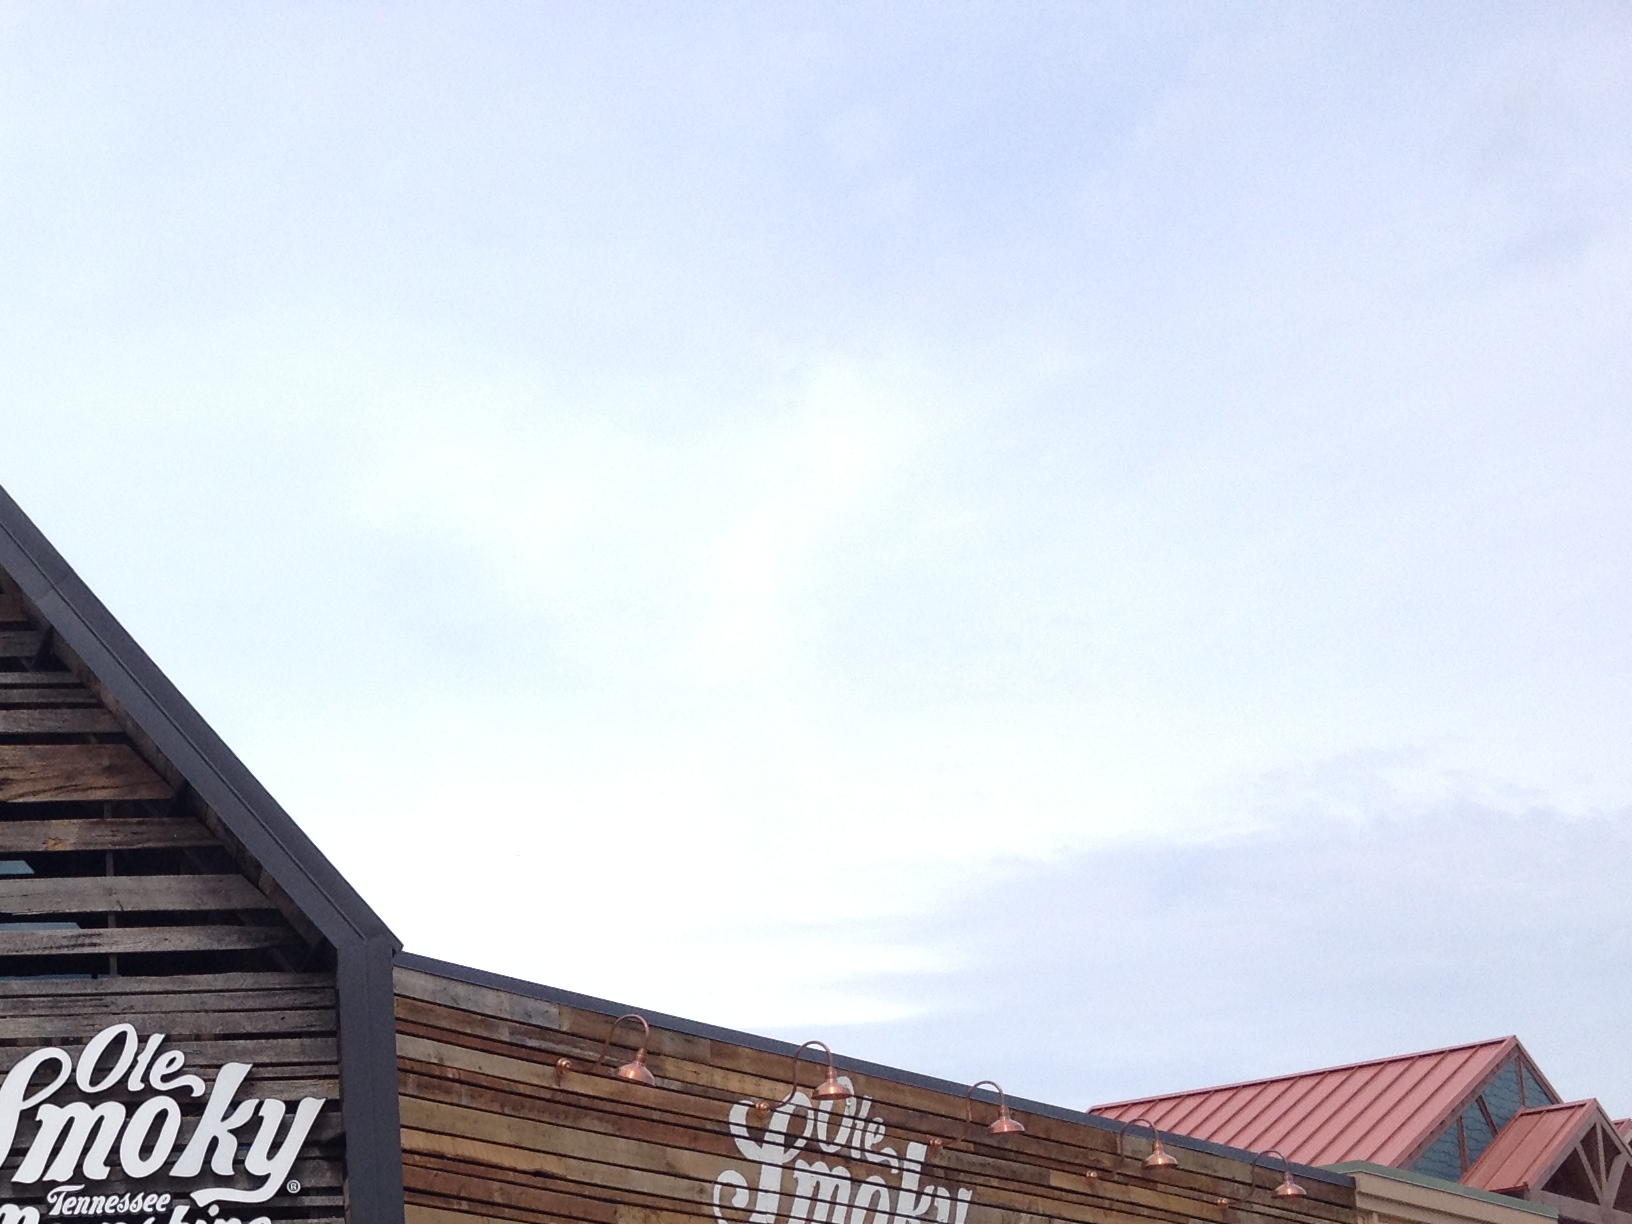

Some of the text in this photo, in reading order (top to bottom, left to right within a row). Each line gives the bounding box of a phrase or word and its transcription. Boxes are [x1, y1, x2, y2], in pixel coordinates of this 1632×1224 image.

[76, 1023, 205, 1097] Ole
[816, 1076, 898, 1173] Ole
[46, 1184, 172, 1215] Tennessee
